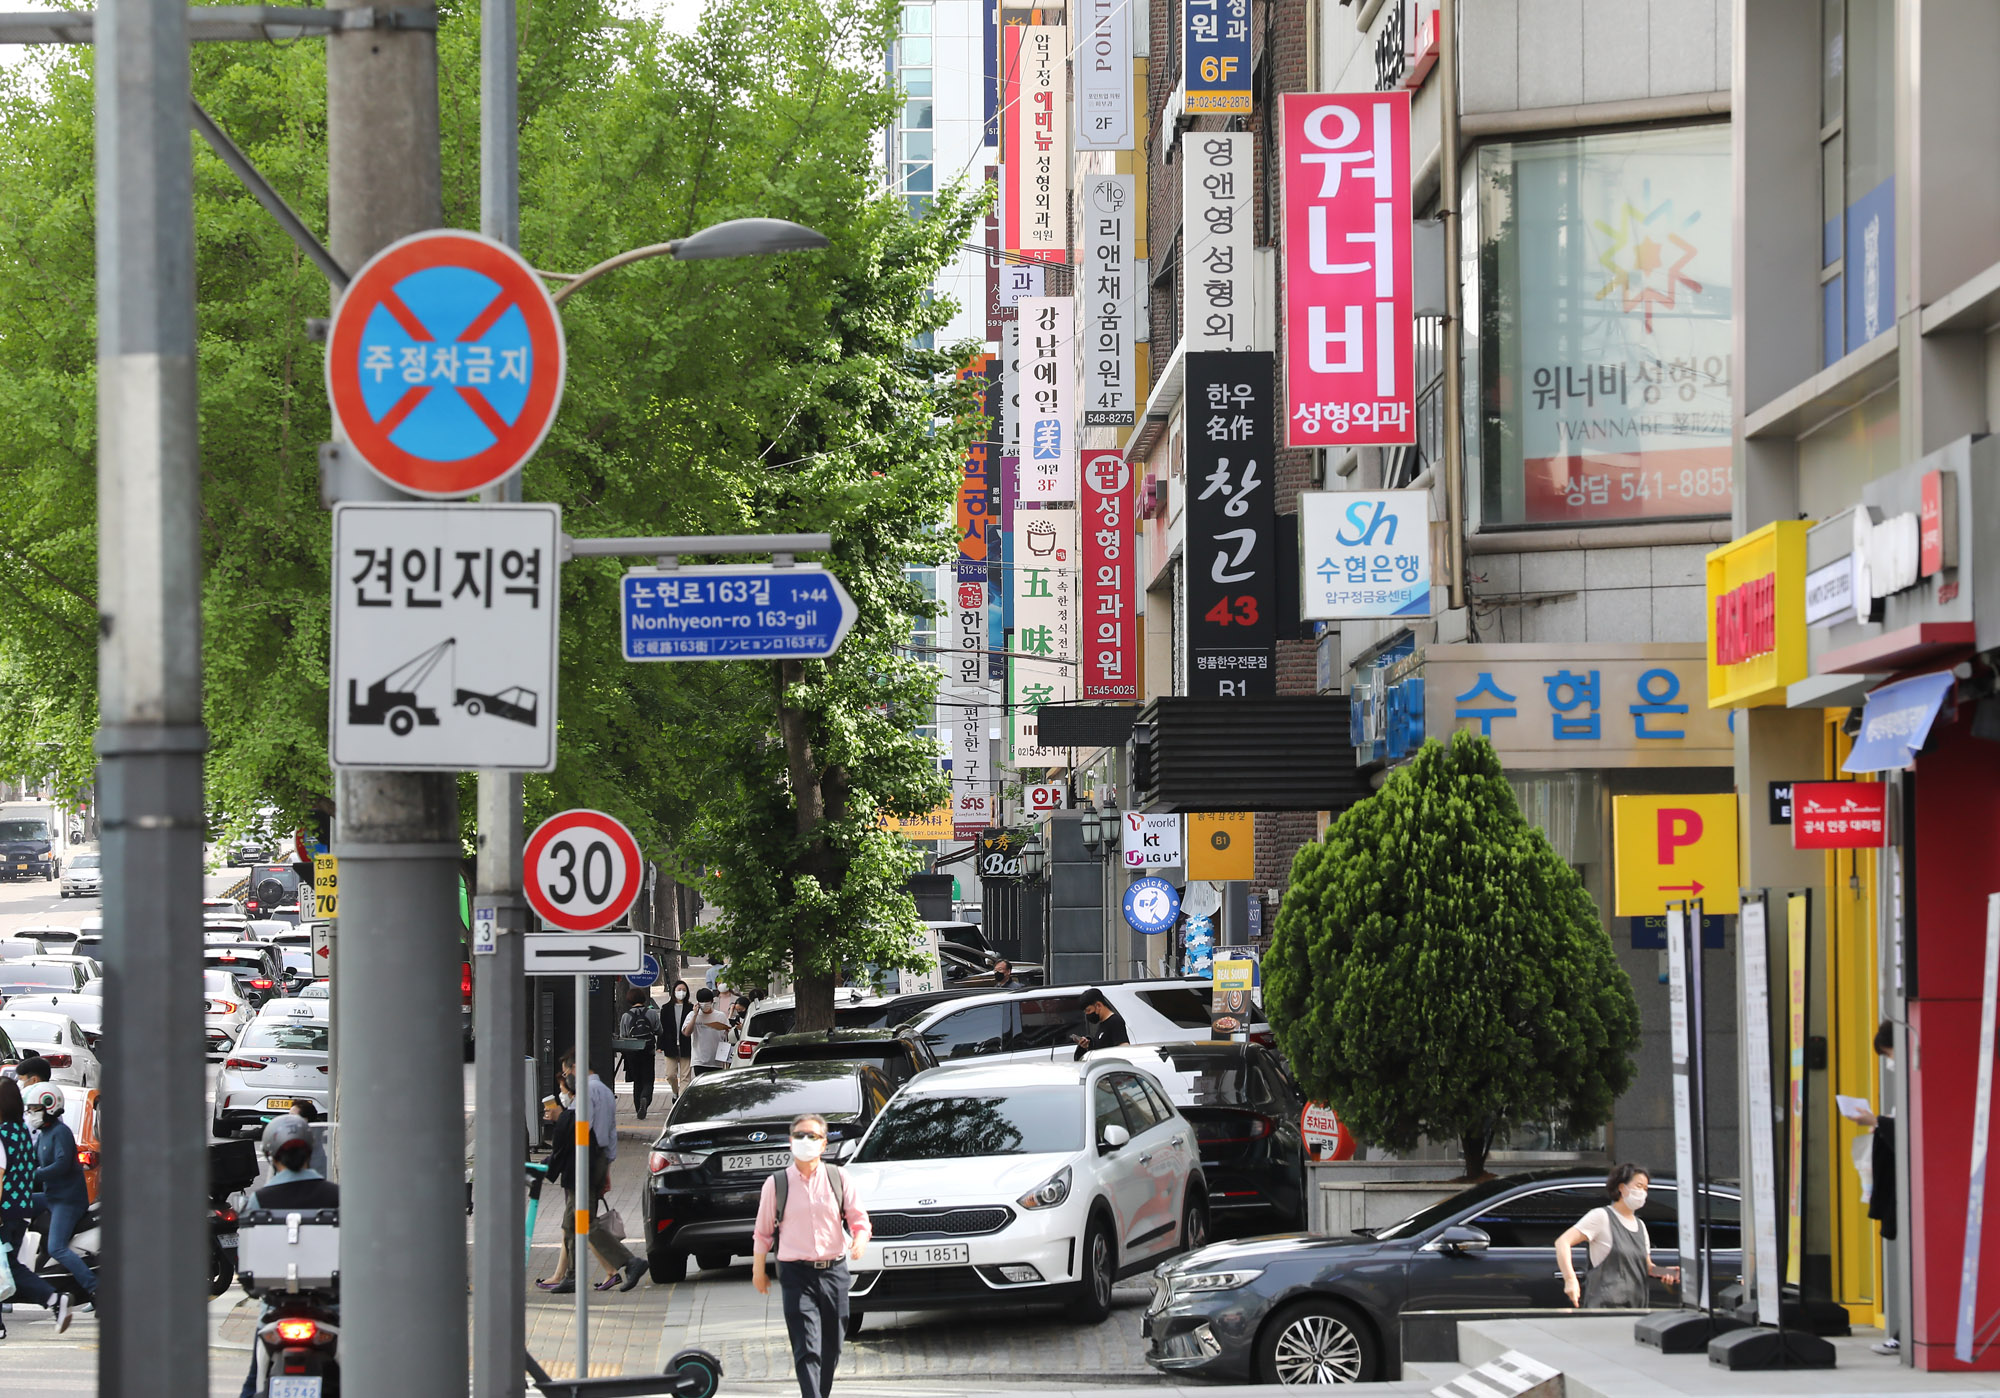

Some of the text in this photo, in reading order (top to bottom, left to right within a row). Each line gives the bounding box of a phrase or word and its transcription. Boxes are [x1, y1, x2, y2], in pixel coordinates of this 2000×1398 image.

[1200, 56, 1239, 82] 6F
[1095, 117, 1112, 130] 2F
[1032, 34, 1053, 241] 압구정 에비뉴 성형외과 의원
[1202, 138, 1236, 352] 영앤영성형외
[1300, 102, 1395, 397] 워너비
[1096, 218, 1122, 388] 리앤채움의원
[363, 344, 528, 385] 주정차금지
[1033, 306, 1060, 413] 강남예일
[1097, 393, 1123, 408] 4F
[1206, 383, 1255, 410] 한우
[1087, 413, 1133, 424] 548-8275
[1206, 415, 1254, 441] 名作
[1292, 402, 1411, 434] 성형외과
[1556, 414, 1664, 441] WANNABE
[1671, 411, 1730, 435] 整形外
[1034, 420, 1060, 458] 美
[1037, 479, 1057, 491] 3F
[1564, 475, 1611, 506] 상담
[1197, 457, 1262, 584] 창고
[1335, 501, 1398, 547] Sh
[351, 546, 541, 609] 견인지역
[1316, 554, 1420, 584] 수협은행
[631, 579, 771, 608] 논현로163길
[1095, 497, 1124, 680] 성형외과의원
[1325, 590, 1412, 605] 압구정금융센터
[631, 610, 818, 632] Nonhyeon-ro 163-gil
[1205, 595, 1260, 627] 43
[960, 611, 983, 683] 한의원
[1197, 655, 1268, 670] 명품한우전문점
[1086, 685, 1136, 696] T.545-0025
[1454, 668, 1735, 740] 수협은
[963, 706, 980, 753] 편안한
[1017, 745, 1067, 757] 02)543-114
[1147, 818, 1176, 828] world
[1656, 808, 1704, 865] P
[1144, 833, 1160, 847] kt
[1216, 837, 1227, 845] B1
[317, 859, 334, 870] 전화
[1146, 850, 1179, 862] LG U+
[548, 839, 613, 905] 30
[316, 894, 338, 913] 70
[1306, 1116, 1334, 1131] 주차금지
[728, 1154, 791, 1170] 22우 1569
[890, 1247, 959, 1264] 19너 1851
[284, 1388, 316, 1398] 5742
